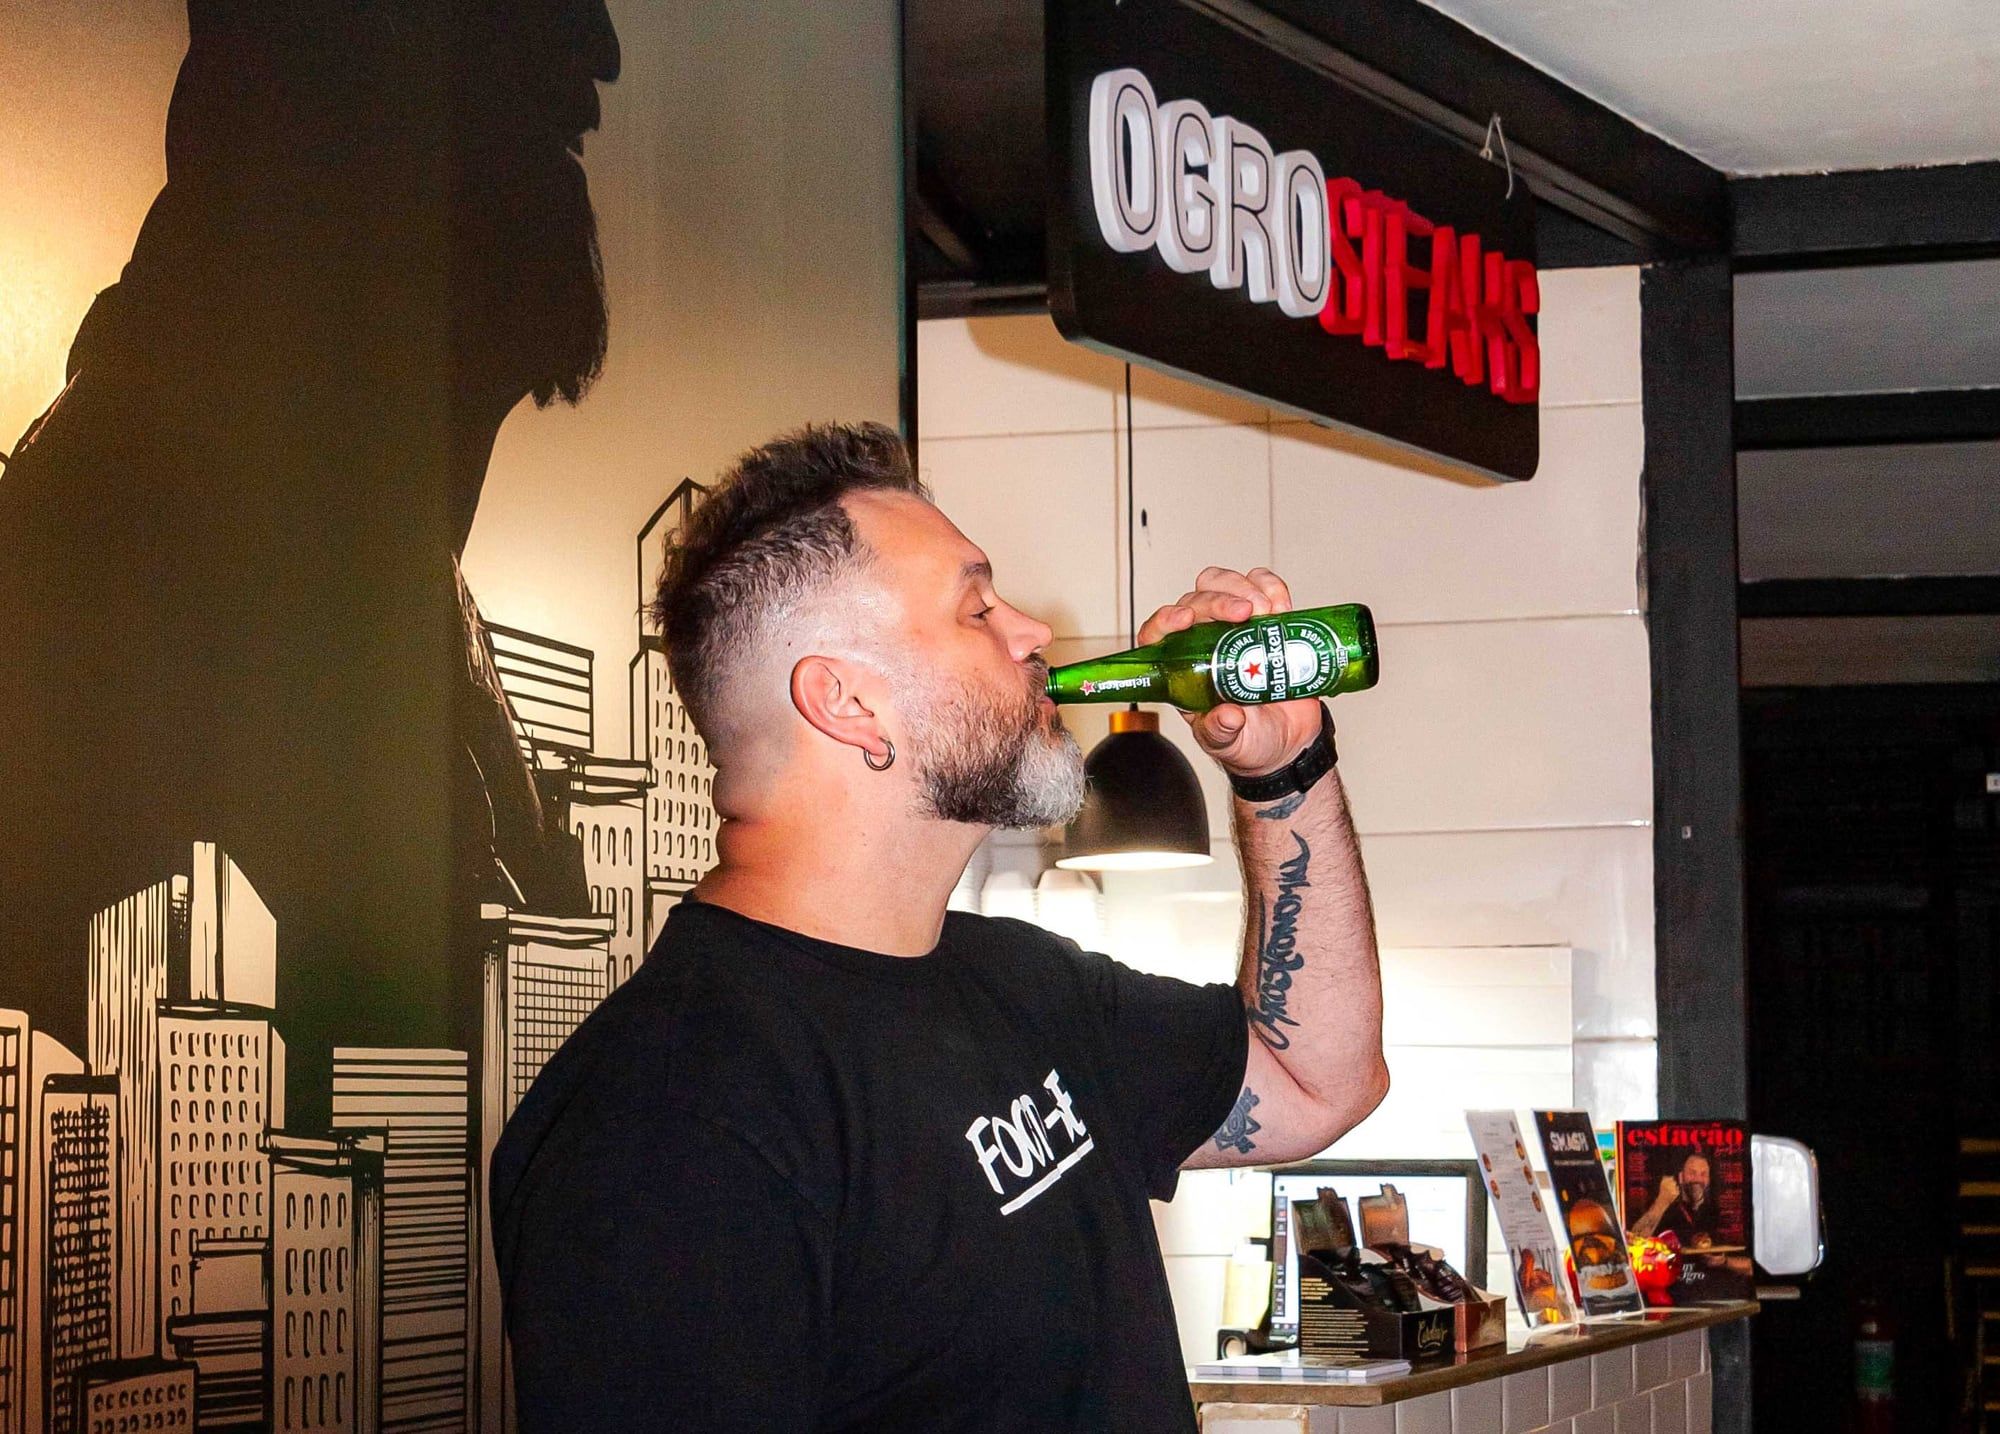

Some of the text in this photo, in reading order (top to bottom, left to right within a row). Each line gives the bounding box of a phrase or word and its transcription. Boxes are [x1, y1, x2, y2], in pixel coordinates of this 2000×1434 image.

[1089, 67, 1331, 318] OGRO
[1098, 677, 1151, 691] Heineken
[1225, 635, 1260, 700] HEINEKEN ORIGINAL
[1266, 625, 1286, 700] Heineken
[1300, 628, 1331, 692] PURE MALT LAGER
[1627, 1122, 1744, 1152] estação
